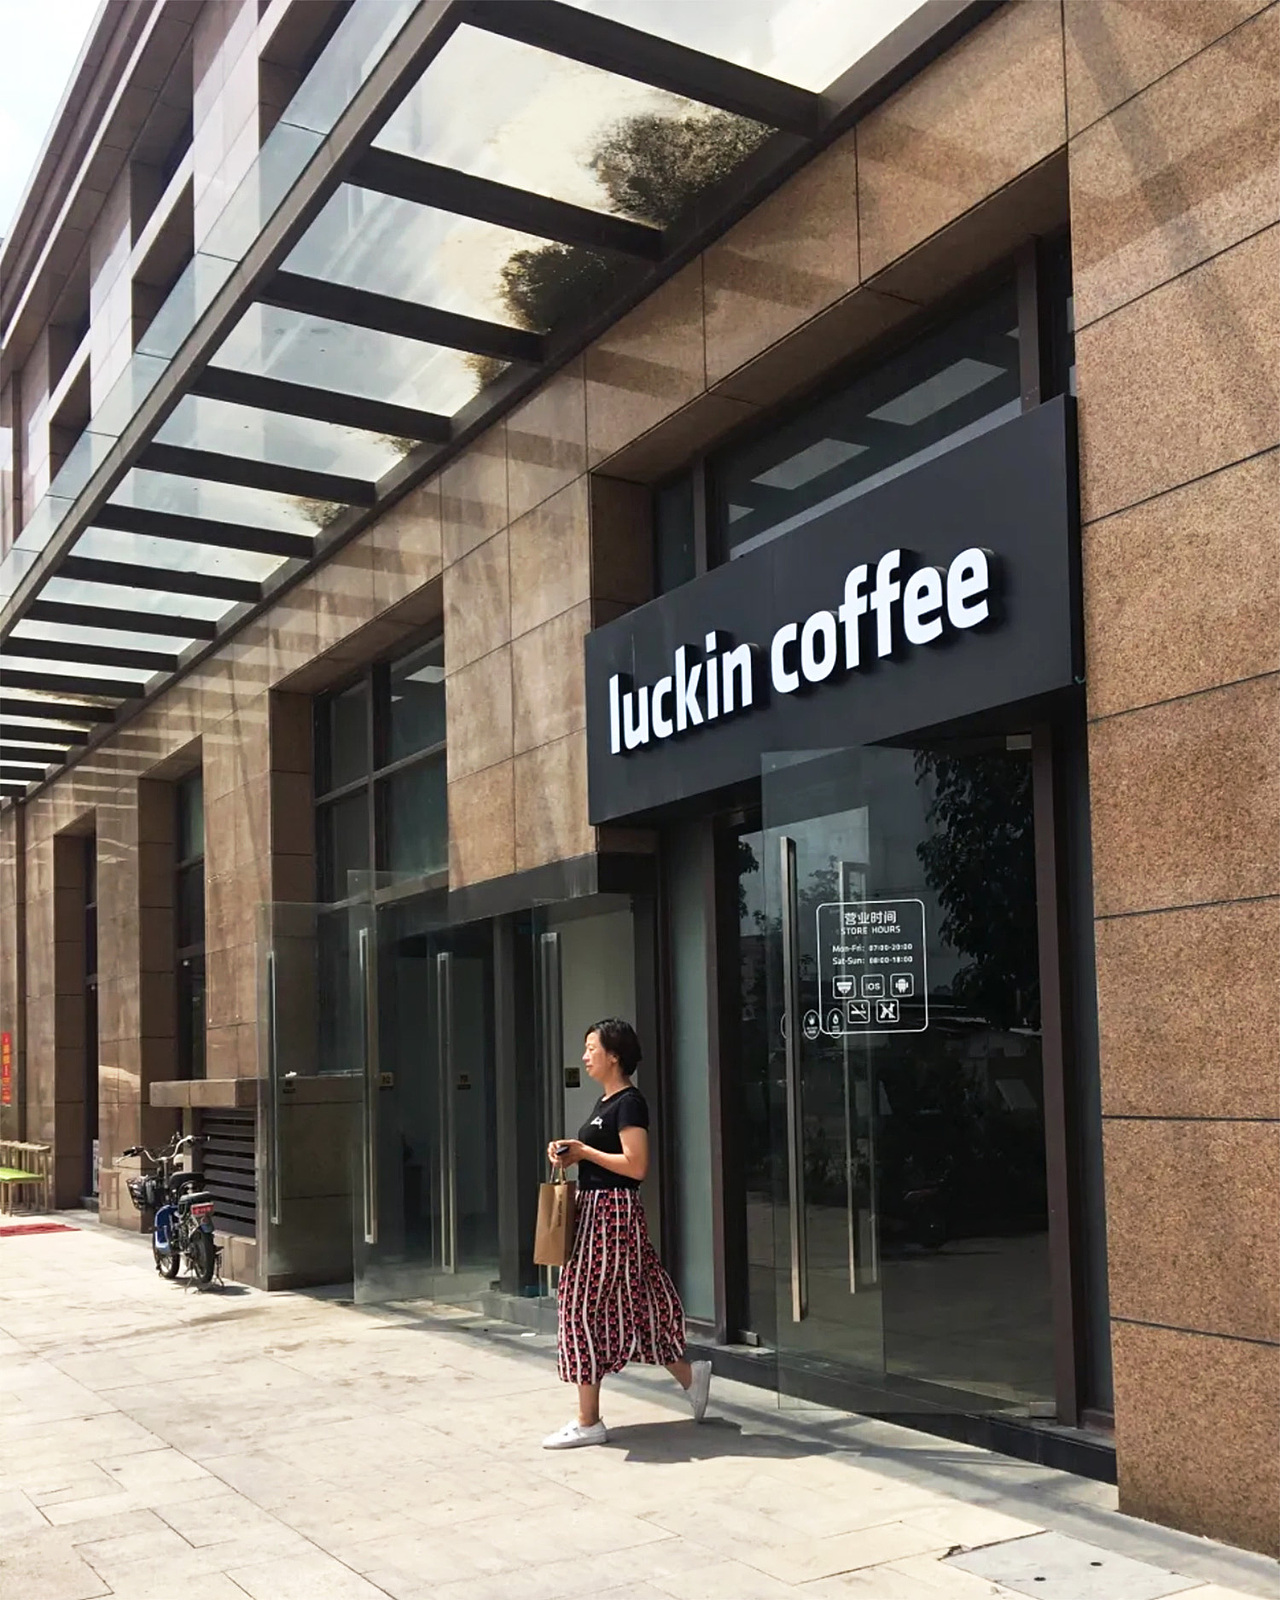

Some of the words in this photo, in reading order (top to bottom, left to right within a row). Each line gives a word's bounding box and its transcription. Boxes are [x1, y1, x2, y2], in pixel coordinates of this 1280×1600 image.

[608, 630, 754, 755] luckin
[770, 546, 991, 694] coffee
[844, 910, 897, 926] 营业时间
[841, 926, 868, 935] STORE
[871, 925, 901, 934] HOURS
[832, 944, 865, 953] Mon-Fri:
[832, 956, 865, 965] Sat-Sun:
